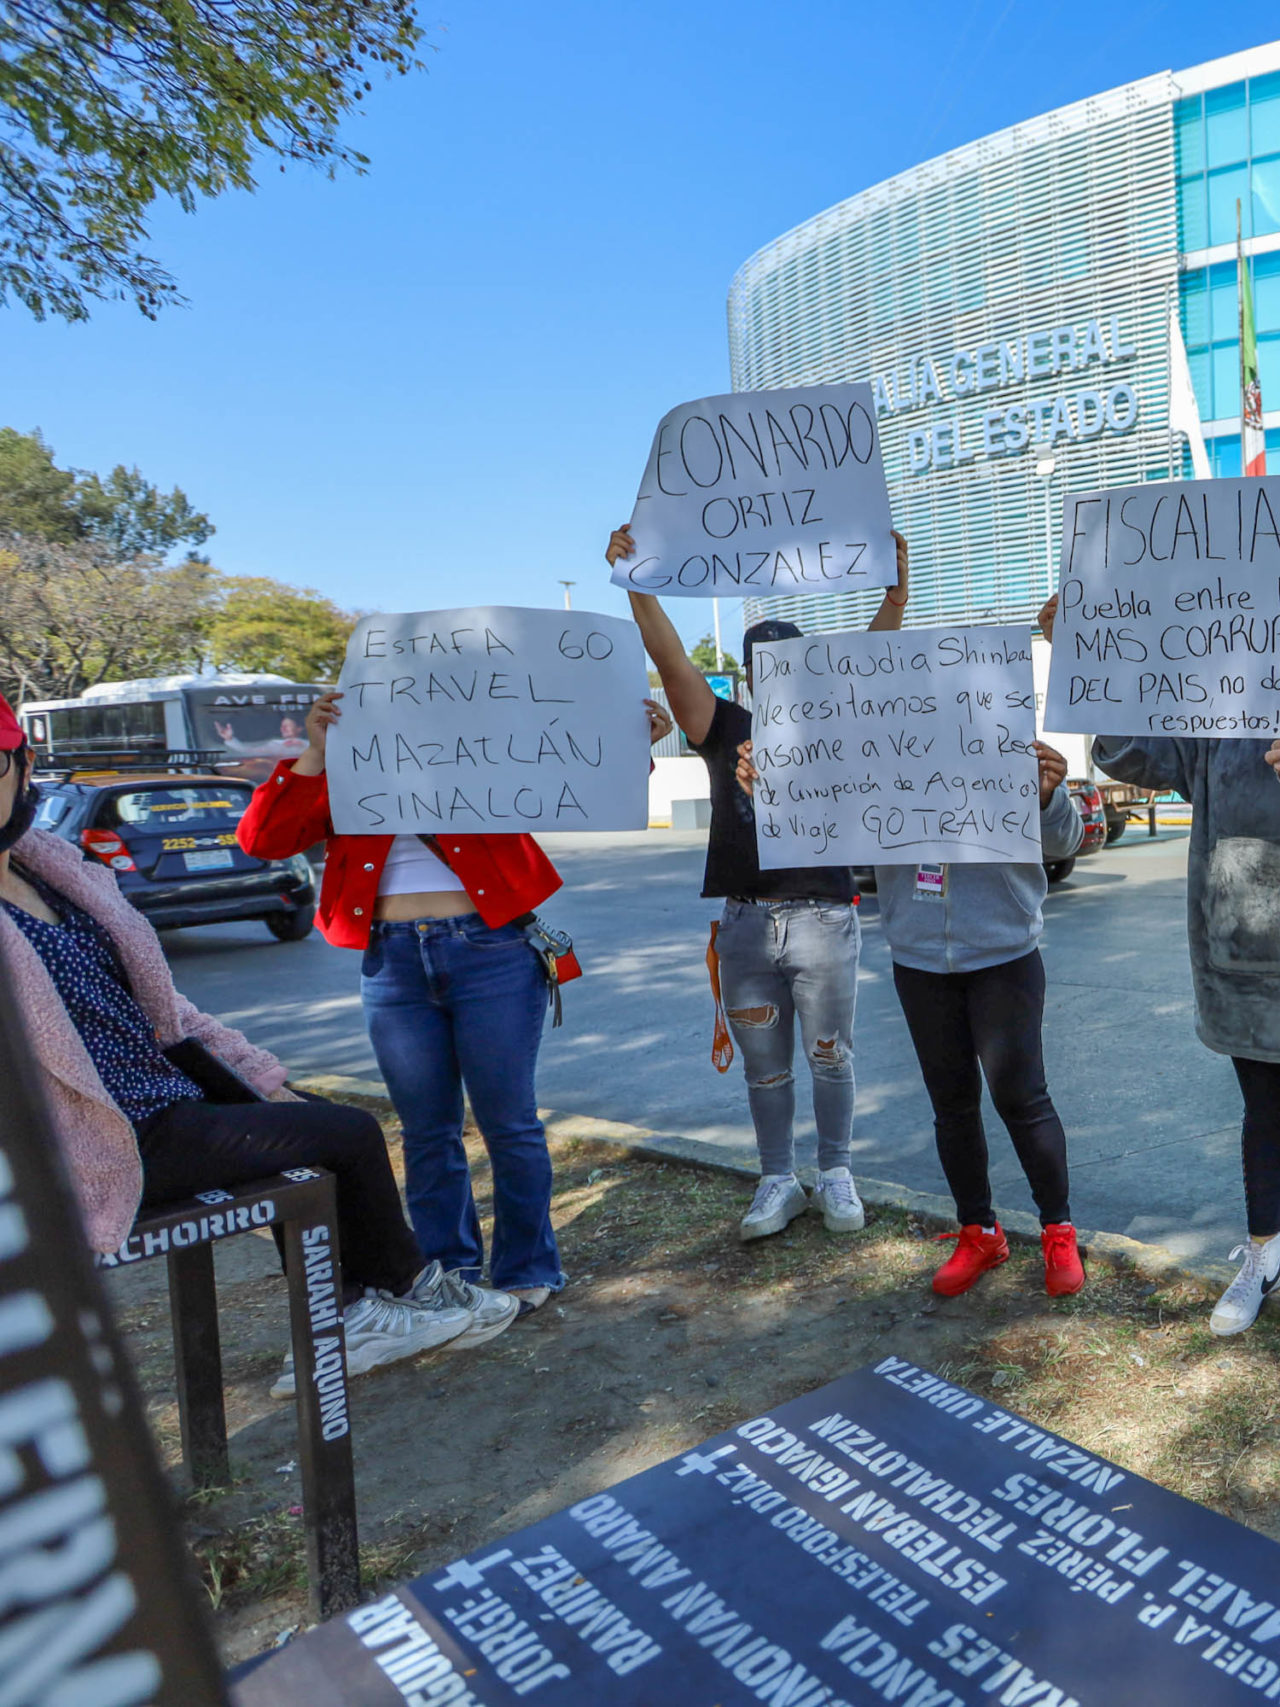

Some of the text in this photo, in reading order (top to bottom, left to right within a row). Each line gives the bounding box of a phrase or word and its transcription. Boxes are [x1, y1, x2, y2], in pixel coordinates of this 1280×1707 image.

[873, 315, 1137, 413] ALÍA GENERAL
[637, 401, 874, 500] EONARDO
[908, 383, 1138, 473] DEL ESTADO
[702, 489, 823, 539] ORTIZ
[628, 542, 868, 589] GONZALEZ
[1062, 579, 1151, 623] Puebla
[1175, 577, 1254, 612] entre
[804, 641, 932, 676] Claudia
[1075, 627, 1147, 662] MAS
[214, 694, 266, 705] AVE
[350, 670, 575, 707] TRAVEL
[755, 683, 1033, 734] Necesitamos que se
[1069, 675, 1122, 705] DEL
[1220, 674, 1245, 695] no
[352, 717, 602, 773] MAZATLÁN
[756, 739, 845, 771] asome
[862, 740, 880, 757] a
[959, 725, 984, 756] la
[357, 781, 588, 826] SINALOA
[760, 777, 780, 806] de
[894, 772, 915, 791] de
[162, 837, 197, 850] 2252
[762, 814, 781, 839] de
[862, 804, 904, 846] GO
[912, 808, 1041, 844] TRAVEL
[302, 1224, 349, 1442] SARAHÍ AQUINO
[873, 1355, 1126, 1496] NIZALLE UBIETA
[808, 1413, 1019, 1553] TECHALOTZIN
[737, 1417, 1008, 1606] ESTEBAN IGNACIO
[992, 1473, 1170, 1577] FLORES
[569, 1494, 694, 1591] AMARO
[716, 1463, 931, 1627] TELESFORO DÍAZ
[1018, 1529, 1135, 1605] PÉREZ
[510, 1544, 663, 1678] RAMÍREZ
[1137, 1592, 1178, 1630] P.
[444, 1588, 572, 1696] JORGE
